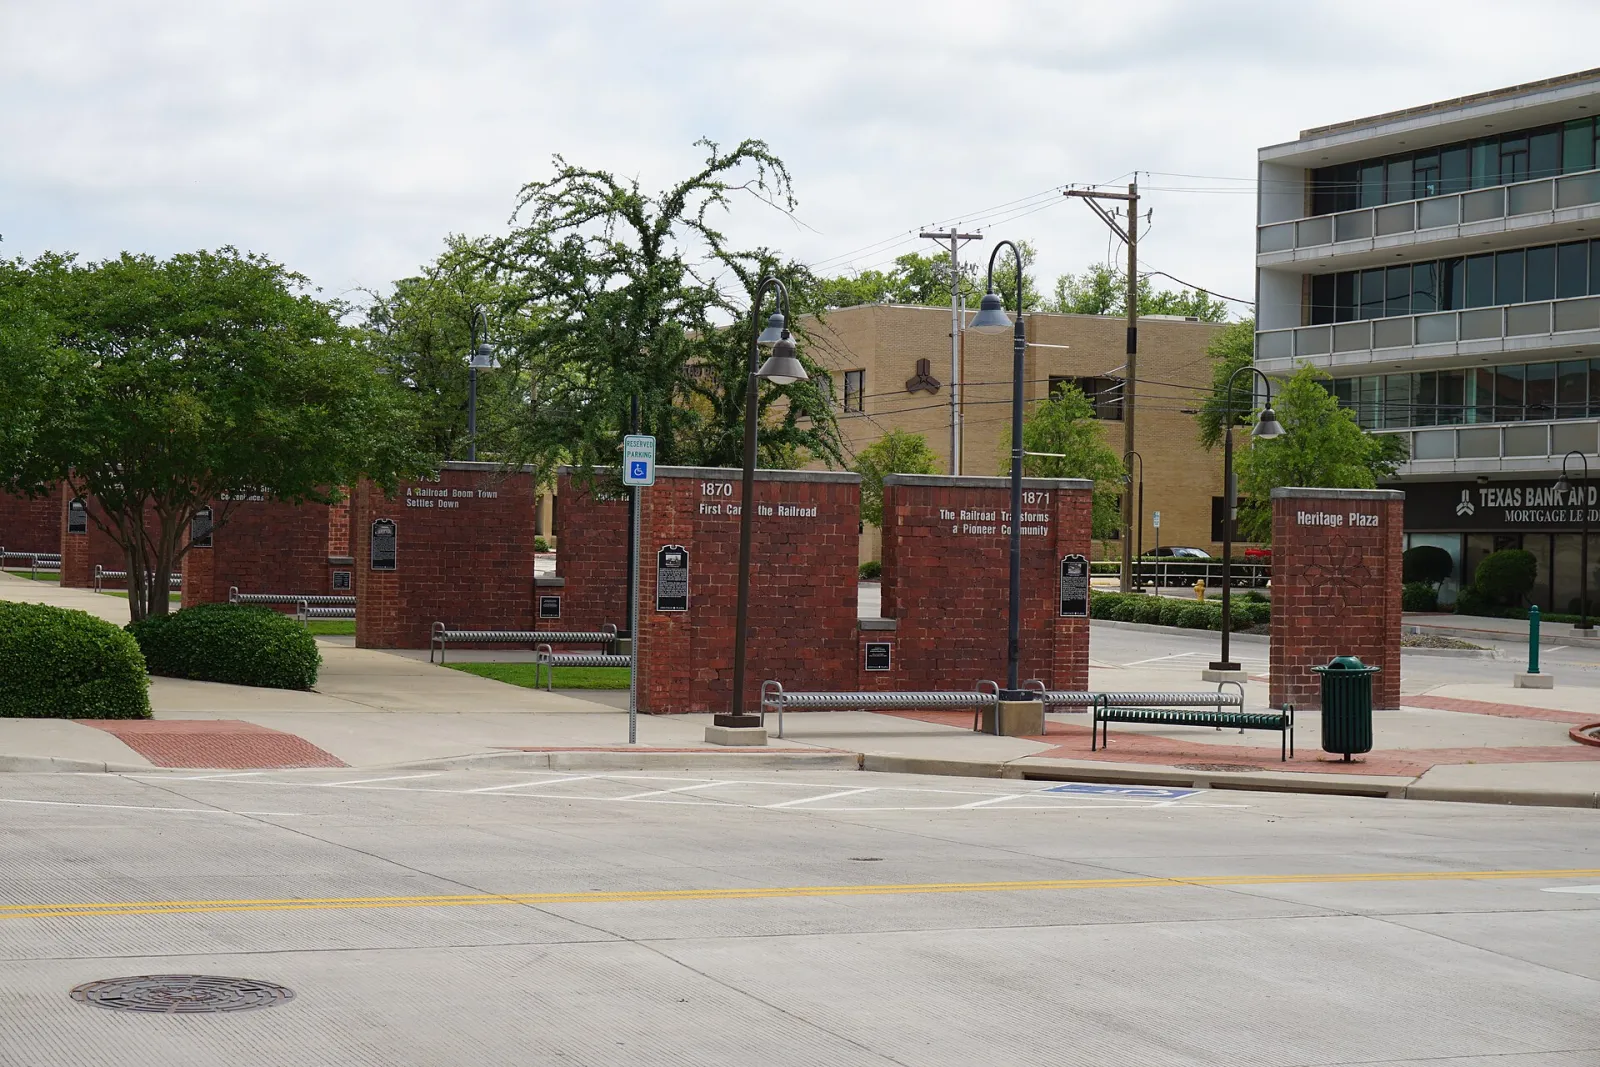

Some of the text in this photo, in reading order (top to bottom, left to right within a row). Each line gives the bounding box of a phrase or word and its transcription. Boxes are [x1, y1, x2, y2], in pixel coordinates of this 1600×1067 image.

[626, 440, 653, 448] RESERVED
[626, 451, 652, 459] PARKING
[406, 487, 412, 496] A
[452, 489, 474, 498] Boom
[478, 489, 498, 499] Town
[700, 482, 732, 496] 1870
[406, 499, 460, 508] Settles Down
[1022, 491, 1050, 504] 1871
[1479, 487, 1522, 507] TEXAS
[1525, 487, 1563, 506] BANK
[699, 503, 721, 515] First
[758, 505, 773, 516] the
[778, 505, 817, 517] Railroad
[940, 509, 1049, 523] The Railroad Trsforms
[1504, 509, 1600, 522] MORTGAGE LED
[1297, 511, 1379, 527] Heritage Plaza
[952, 524, 1049, 537] a Pioneer Comunity
